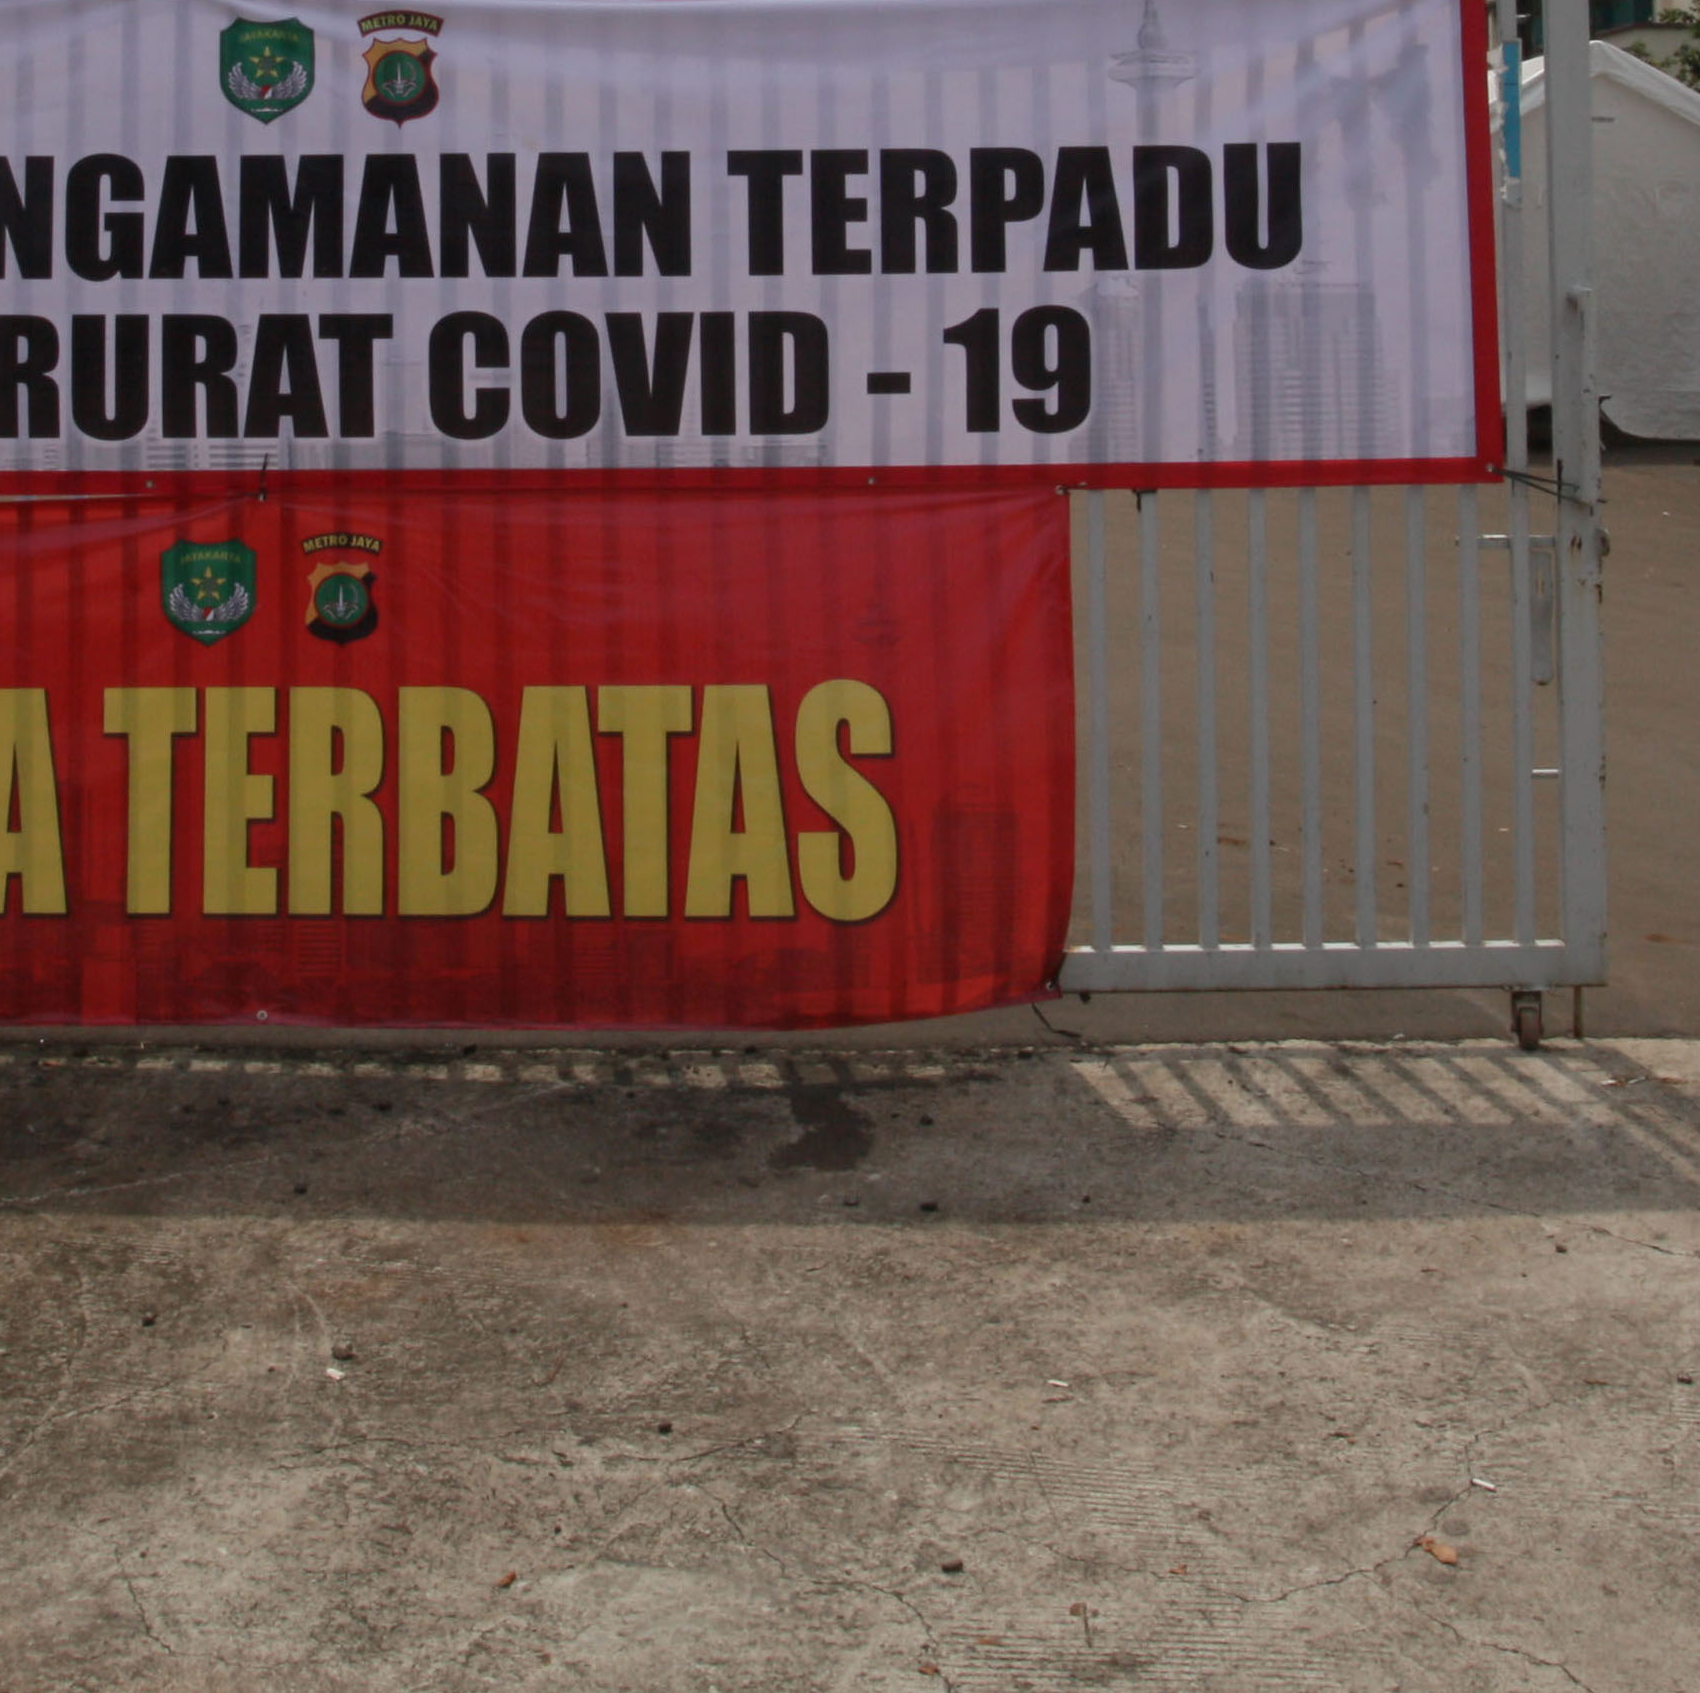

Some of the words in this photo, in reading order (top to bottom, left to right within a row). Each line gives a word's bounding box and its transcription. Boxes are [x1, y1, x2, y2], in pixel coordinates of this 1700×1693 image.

[361, 14, 405, 33] METRO
[408, 14, 439, 31] JAYA
[727, 142, 1303, 276] TERPADU
[428, 310, 830, 440] COVID
[943, 305, 1091, 434] 19
[302, 534, 348, 553] METRO
[351, 535, 381, 553] JAYA
[103, 678, 897, 921] TERBATAS
